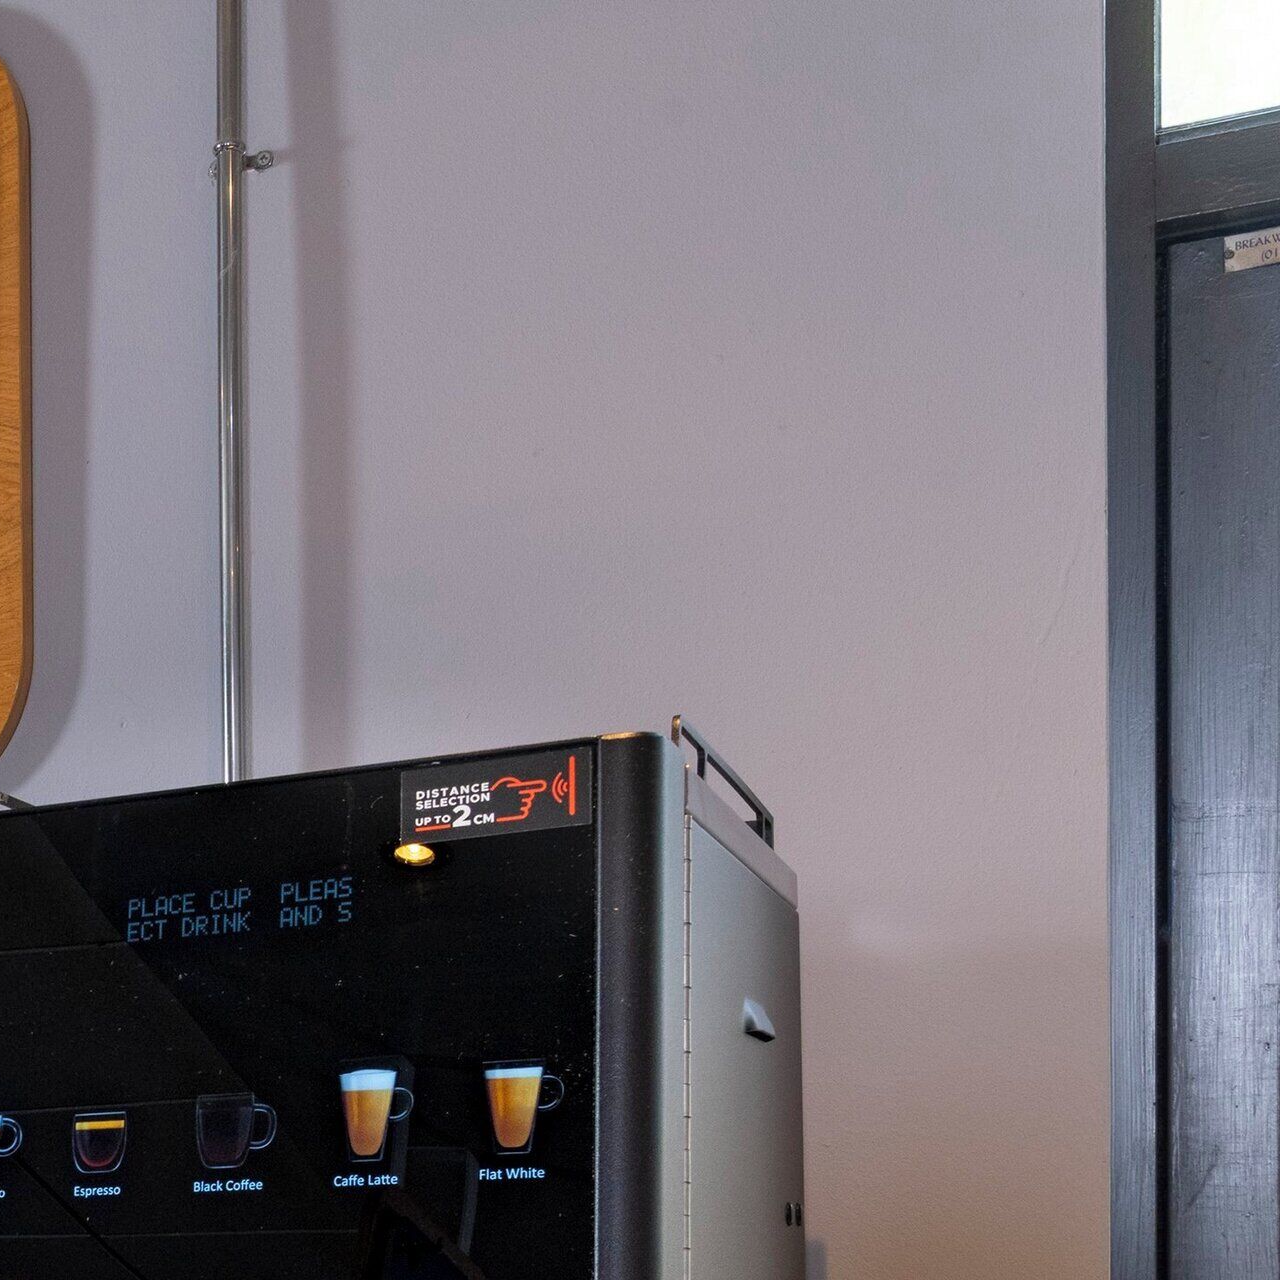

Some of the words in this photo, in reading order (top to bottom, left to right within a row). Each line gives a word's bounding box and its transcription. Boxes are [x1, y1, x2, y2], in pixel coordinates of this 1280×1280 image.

[416, 782, 490, 800] DISTANCE
[415, 792, 490, 811] SELECTION
[415, 816, 432, 827] UP
[434, 814, 451, 824] TO
[452, 804, 471, 828] 2
[473, 812, 495, 825] CM
[128, 893, 196, 919] PLACE
[210, 887, 251, 910] CUP
[280, 876, 353, 904] PLEAS
[127, 919, 167, 943] ECT
[182, 911, 251, 938] DRINK
[280, 904, 323, 929] AND
[338, 901, 352, 923] S
[333, 1174, 364, 1187] Caffe
[368, 1174, 398, 1186] Latte
[479, 1168, 502, 1181] Flat
[506, 1167, 545, 1180] White
[73, 1185, 121, 1199] Espresso
[193, 1180, 223, 1193] Black
[226, 1179, 263, 1192] Coffee
